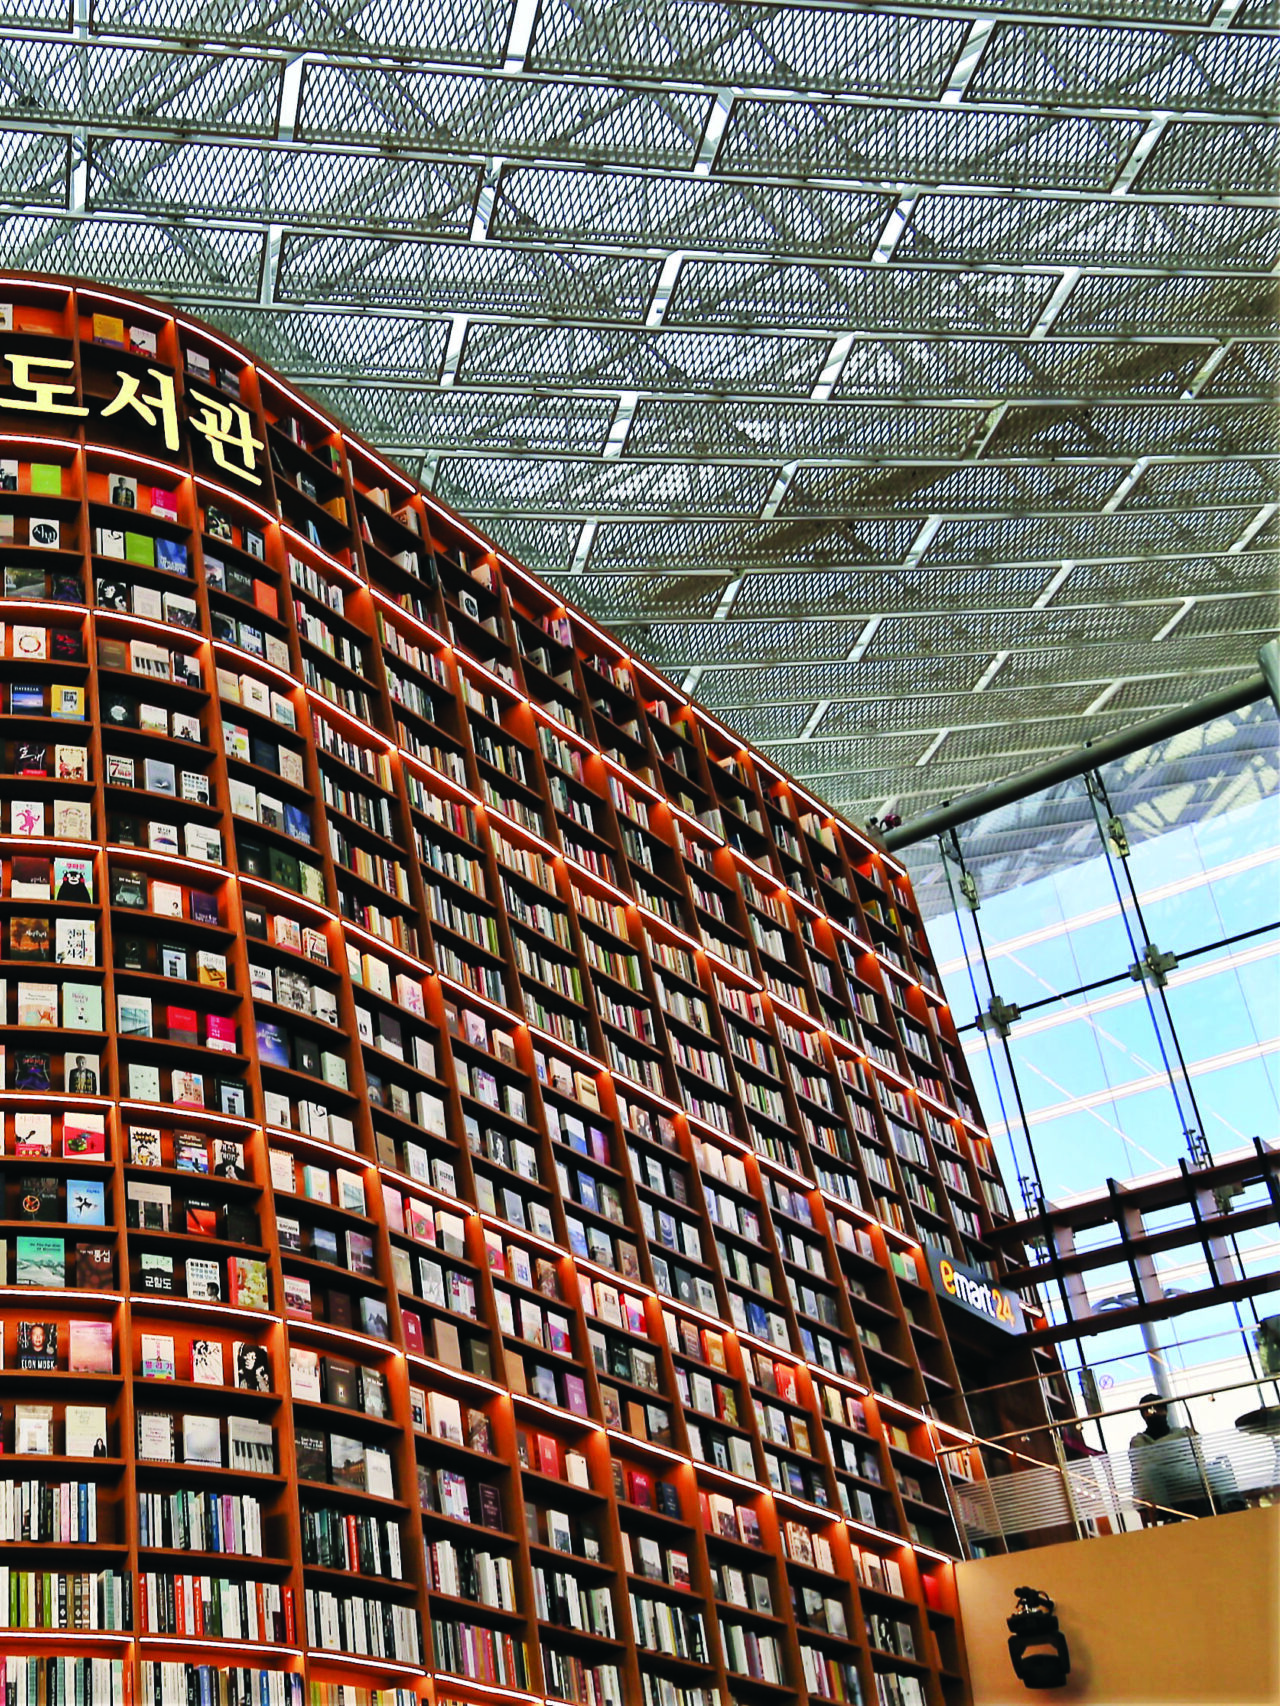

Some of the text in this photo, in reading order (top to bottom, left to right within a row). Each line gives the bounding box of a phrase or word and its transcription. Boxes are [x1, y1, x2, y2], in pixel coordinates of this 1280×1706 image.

[145, 1275, 172, 1290] 군함도
[939, 1259, 1017, 1328] emart24
[21, 1359, 55, 1370] ELON MUSK
